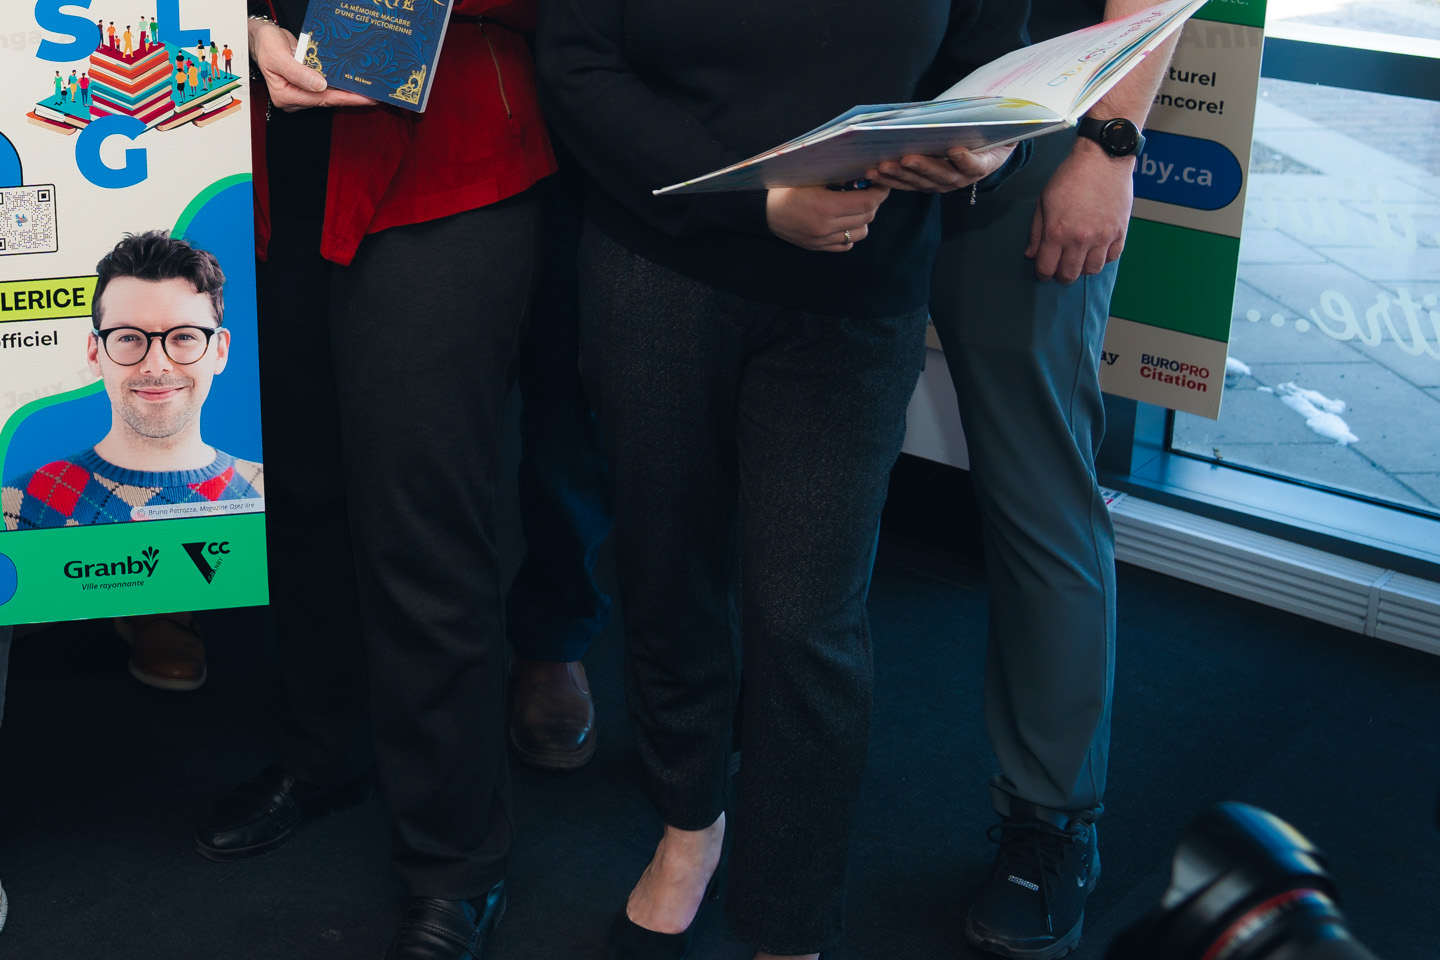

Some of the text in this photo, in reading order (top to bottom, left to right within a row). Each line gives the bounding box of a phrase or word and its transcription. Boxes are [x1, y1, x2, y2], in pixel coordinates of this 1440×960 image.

[335, 8, 412, 35] D'UNE CITÉ VICTORIENNE
[350, 4, 379, 17] MÉMOIRE
[381, 14, 410, 27] MACABRE
[75, 114, 148, 190] G
[1140, 366, 1207, 392] Citation
[1142, 354, 1209, 379] BUROPRO
[64, 556, 160, 579] Granby
[100, 580, 144, 590] rayonnante
